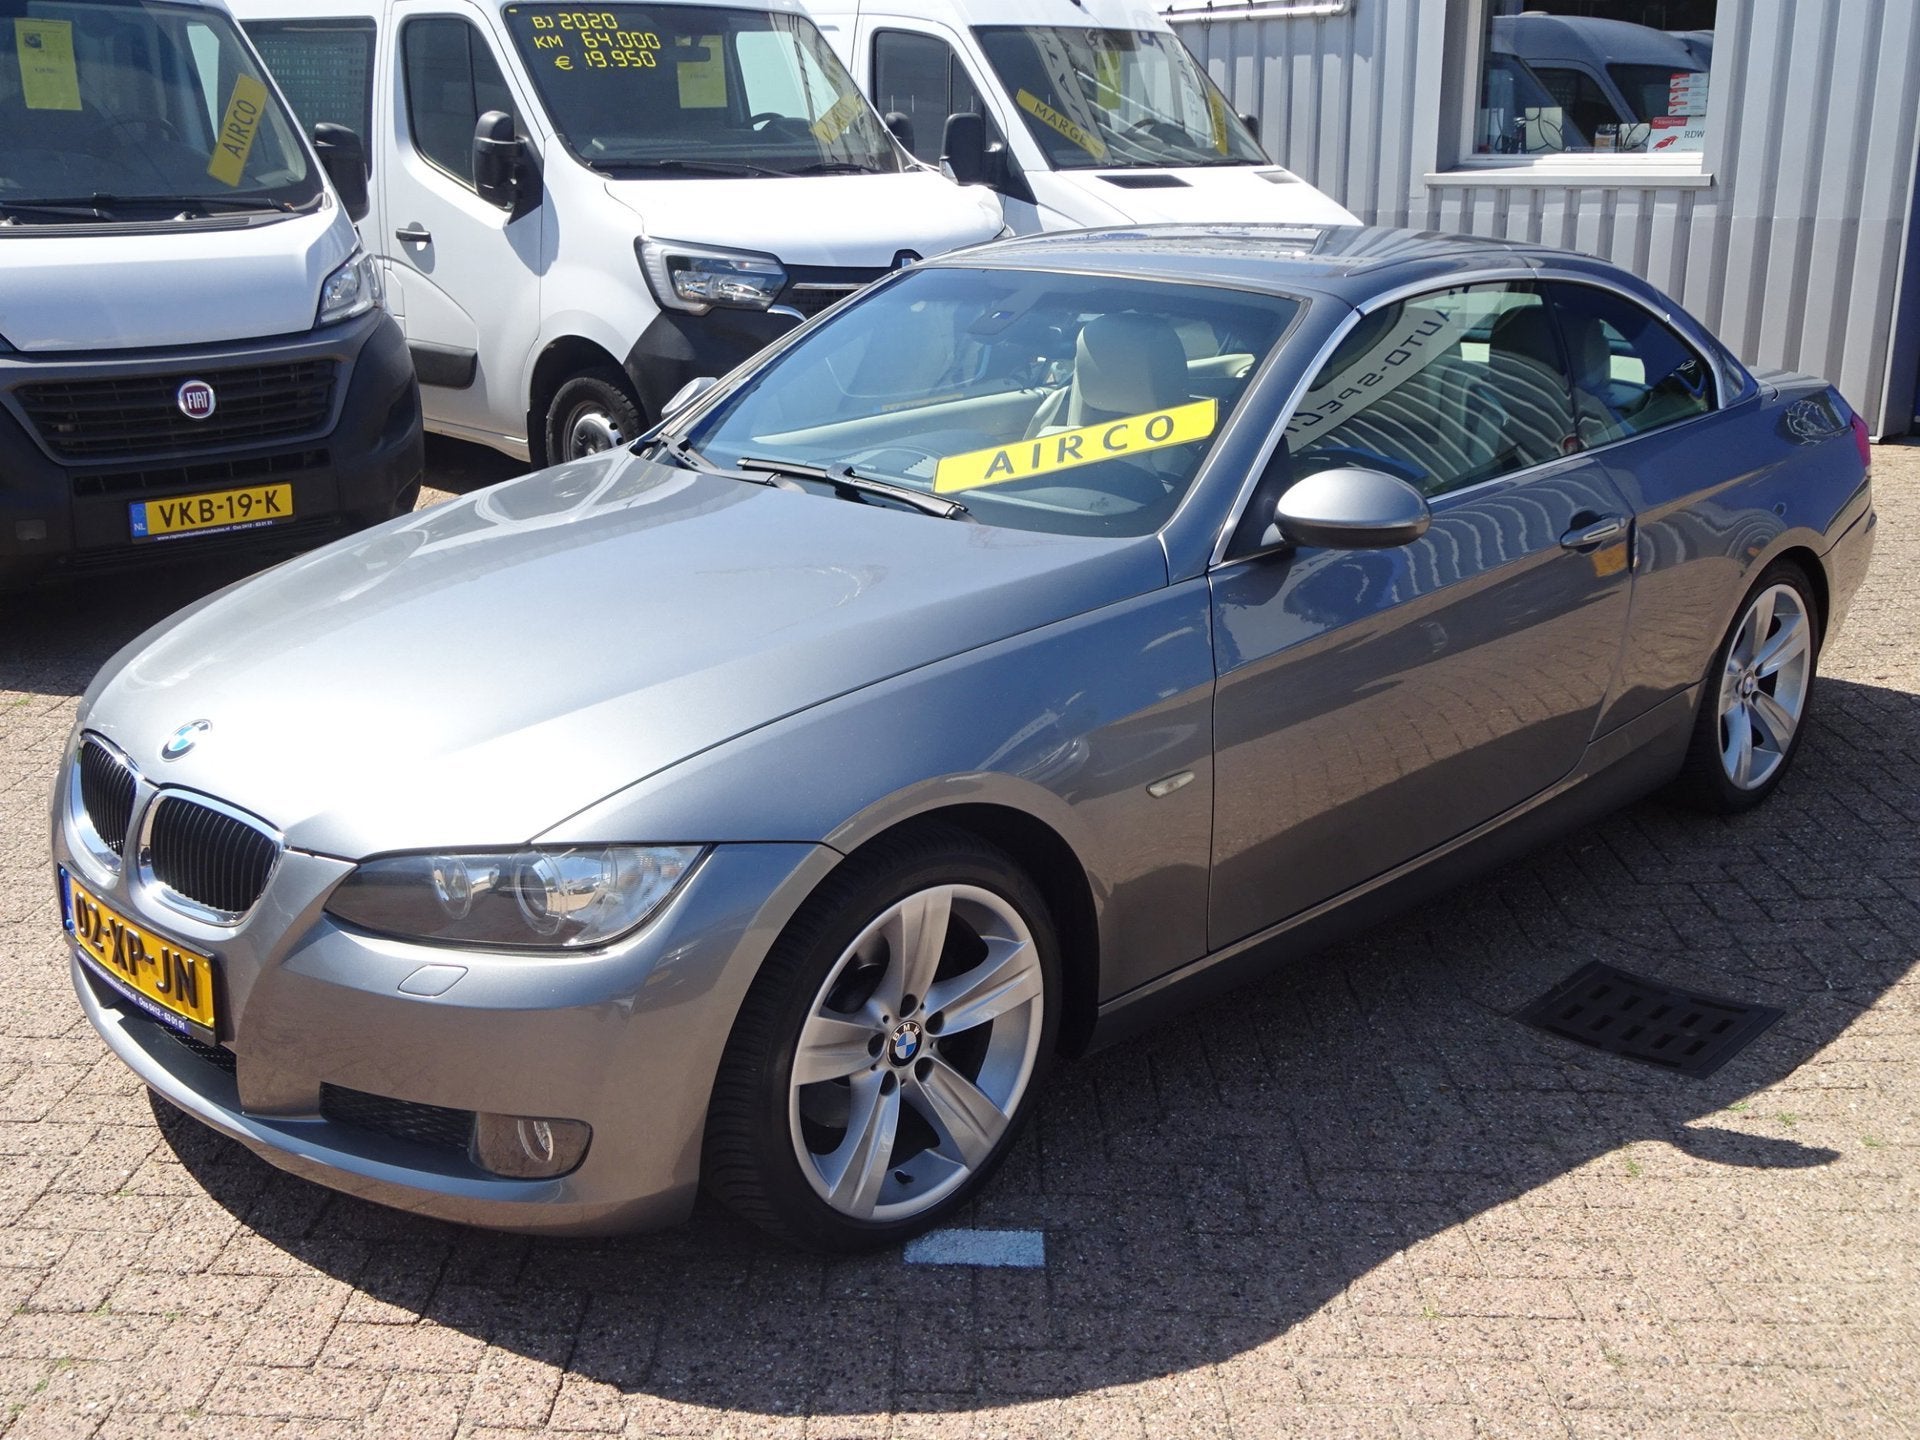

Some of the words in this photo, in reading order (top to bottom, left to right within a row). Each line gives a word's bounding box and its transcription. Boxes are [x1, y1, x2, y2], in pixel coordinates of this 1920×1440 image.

[532, 16, 554, 28] BJ
[559, 13, 618, 29] 2020
[533, 35, 563, 49] KM
[581, 31, 661, 49] 64.000
[554, 56, 573, 70] €
[584, 51, 656, 67] 19.950
[223, 99, 257, 160] AIRCO
[1684, 130, 1705, 139] RDW
[186, 391, 208, 409] FIAT
[983, 415, 1175, 479] AIRCO
[159, 490, 281, 528] VKB-19-K
[133, 522, 146, 531] NL
[75, 891, 198, 1009] 02-XP-JN
[892, 1023, 920, 1042] BMW
